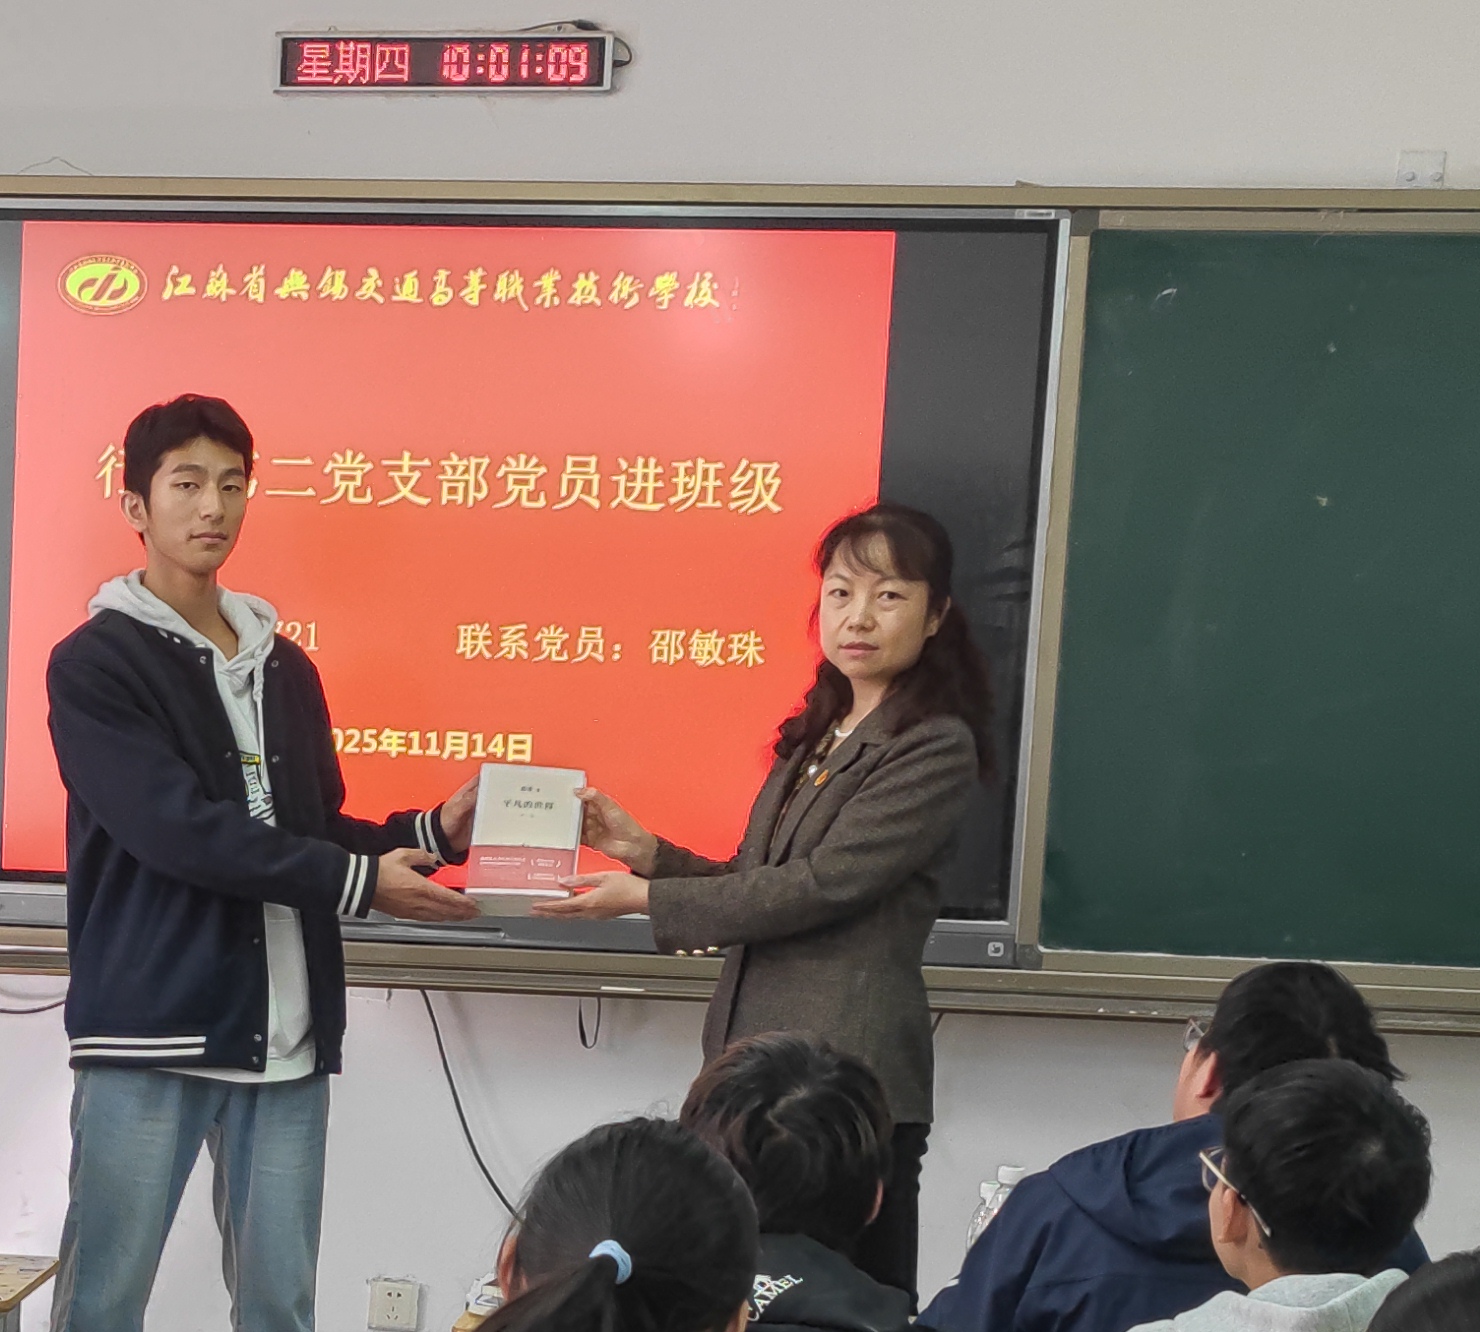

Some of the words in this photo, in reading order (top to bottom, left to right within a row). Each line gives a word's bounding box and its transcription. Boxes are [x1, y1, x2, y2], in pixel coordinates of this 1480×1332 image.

[297, 41, 410, 83] 星期四
[443, 43, 589, 82] 10:01:09
[94, 443, 783, 514] 行二党支部党员进班级
[331, 727, 533, 762] 025年11月14日
